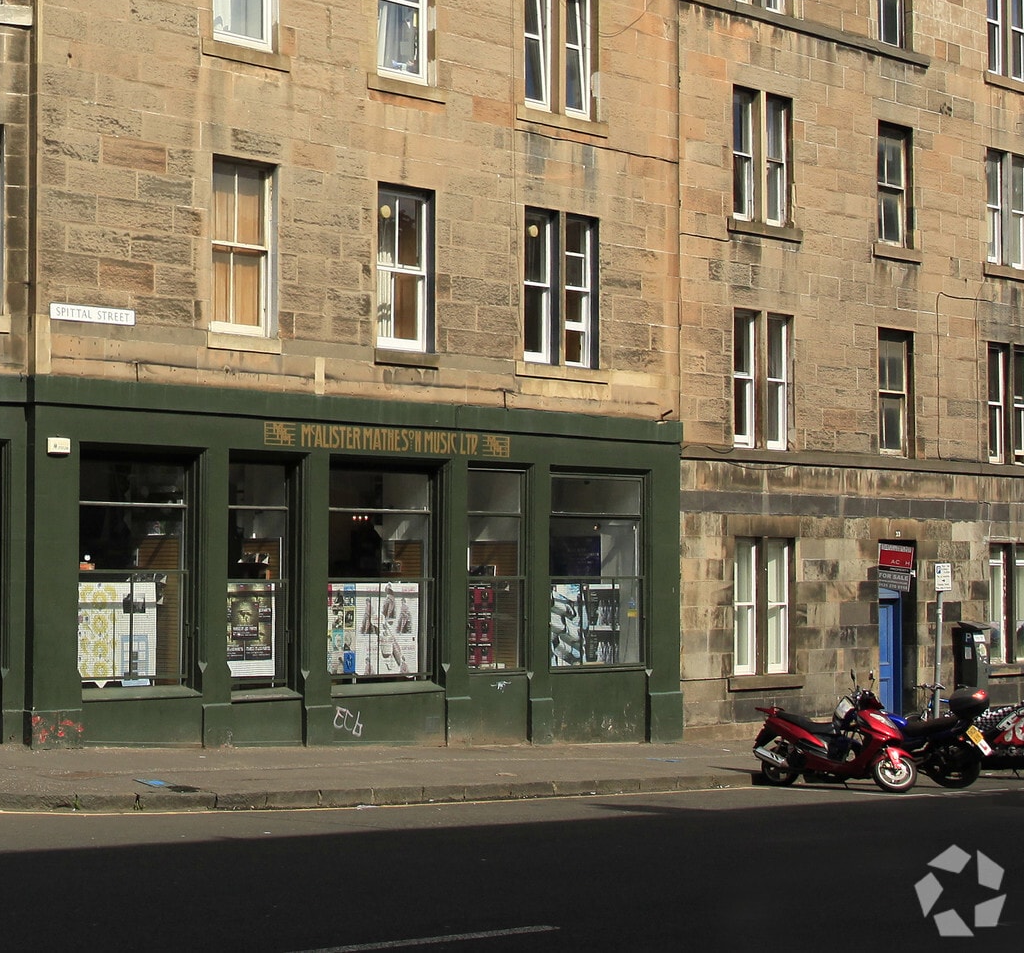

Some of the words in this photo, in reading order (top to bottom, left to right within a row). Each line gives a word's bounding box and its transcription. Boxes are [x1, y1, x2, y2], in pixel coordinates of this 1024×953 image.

[56, 307, 92, 320] SPITTAL
[97, 310, 130, 322] STREET
[425, 431, 457, 454] MUSIC
